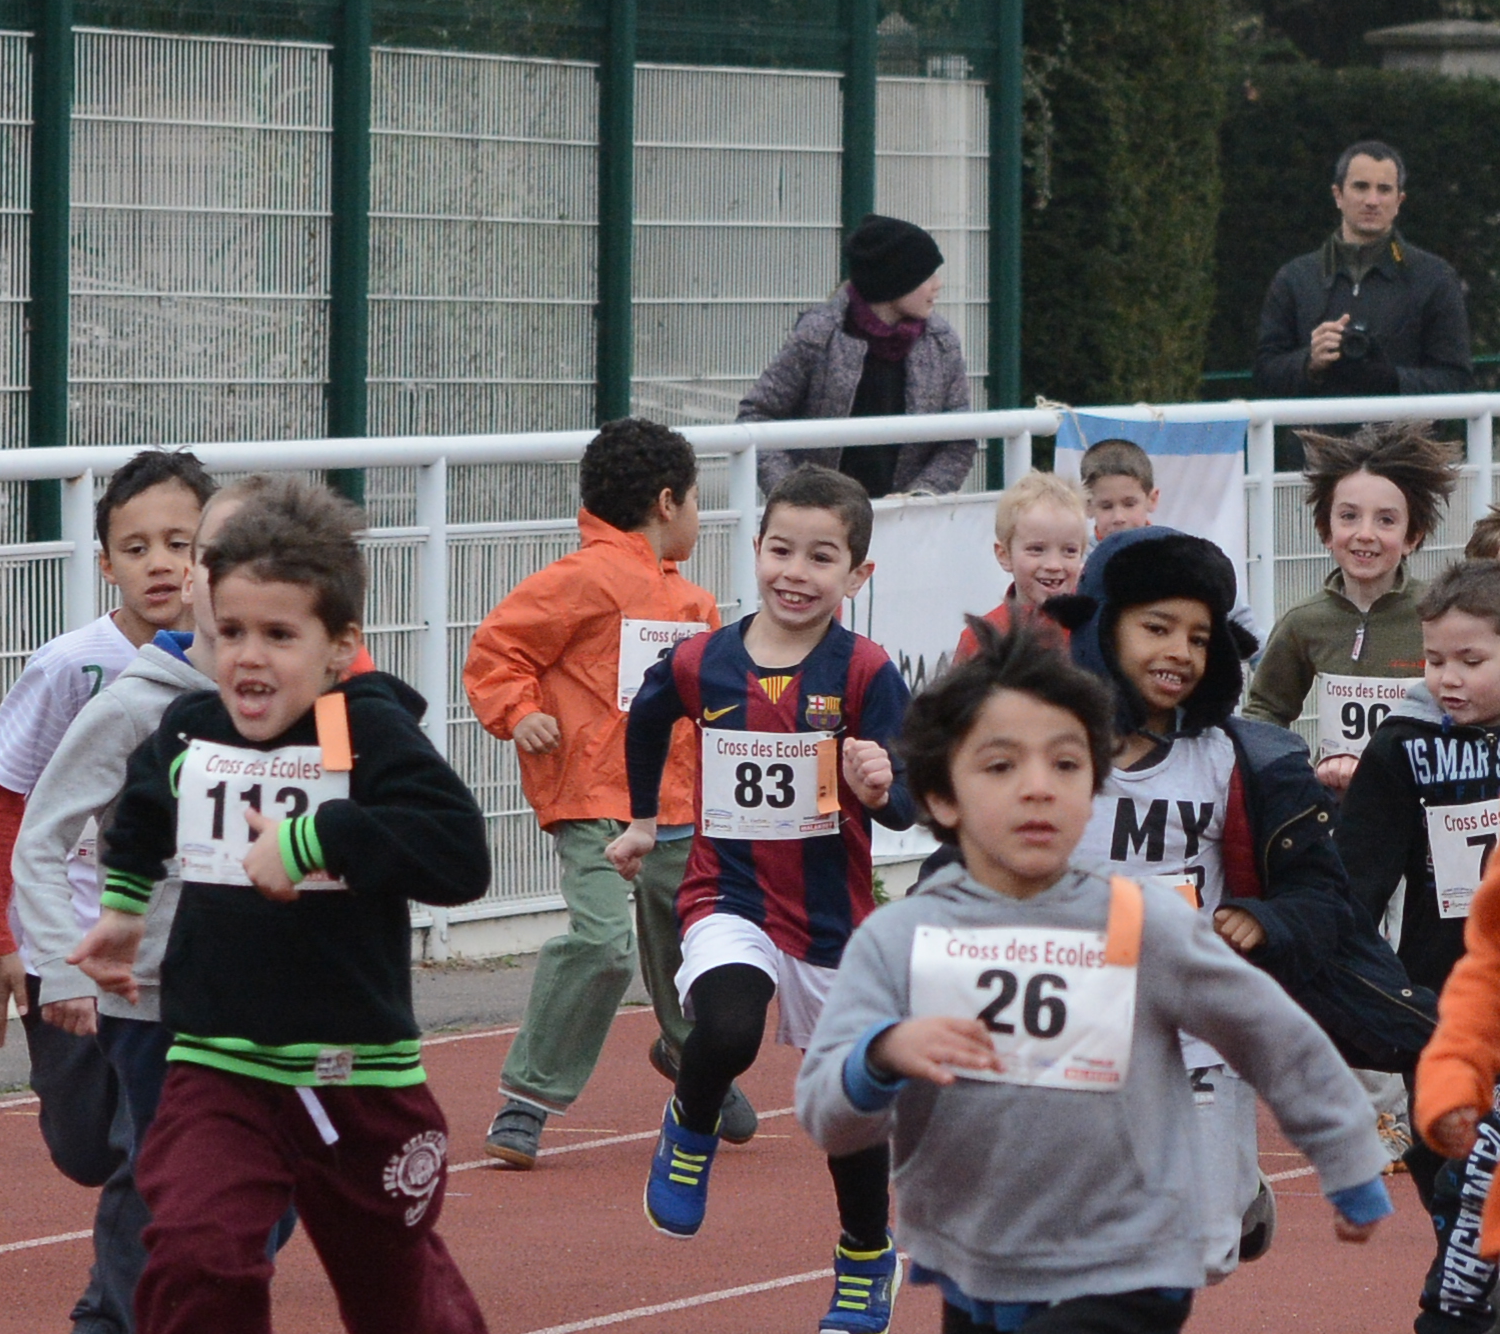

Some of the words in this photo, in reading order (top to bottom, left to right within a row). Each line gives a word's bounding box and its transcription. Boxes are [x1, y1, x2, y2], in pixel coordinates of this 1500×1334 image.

[639, 627, 669, 643] Cross
[1326, 681, 1353, 697] Cross
[1355, 682, 1374, 698] des
[1376, 684, 1406, 699] Ecole
[1341, 702, 1392, 740] 90
[717, 738, 748, 756] Cross
[751, 739, 773, 758] des
[776, 740, 818, 758] Ecoles
[206, 754, 241, 774] Cross
[243, 756, 266, 776] des
[270, 756, 321, 780] Ecoles
[734, 762, 795, 809] 83
[1110, 797, 1215, 862] MY
[1444, 813, 1478, 832] Cross
[1466, 833, 1498, 881] 7
[946, 938, 998, 961] Cross
[1005, 939, 1038, 964] des
[1045, 941, 1105, 968] Ecoles
[976, 969, 1068, 1039] 26
